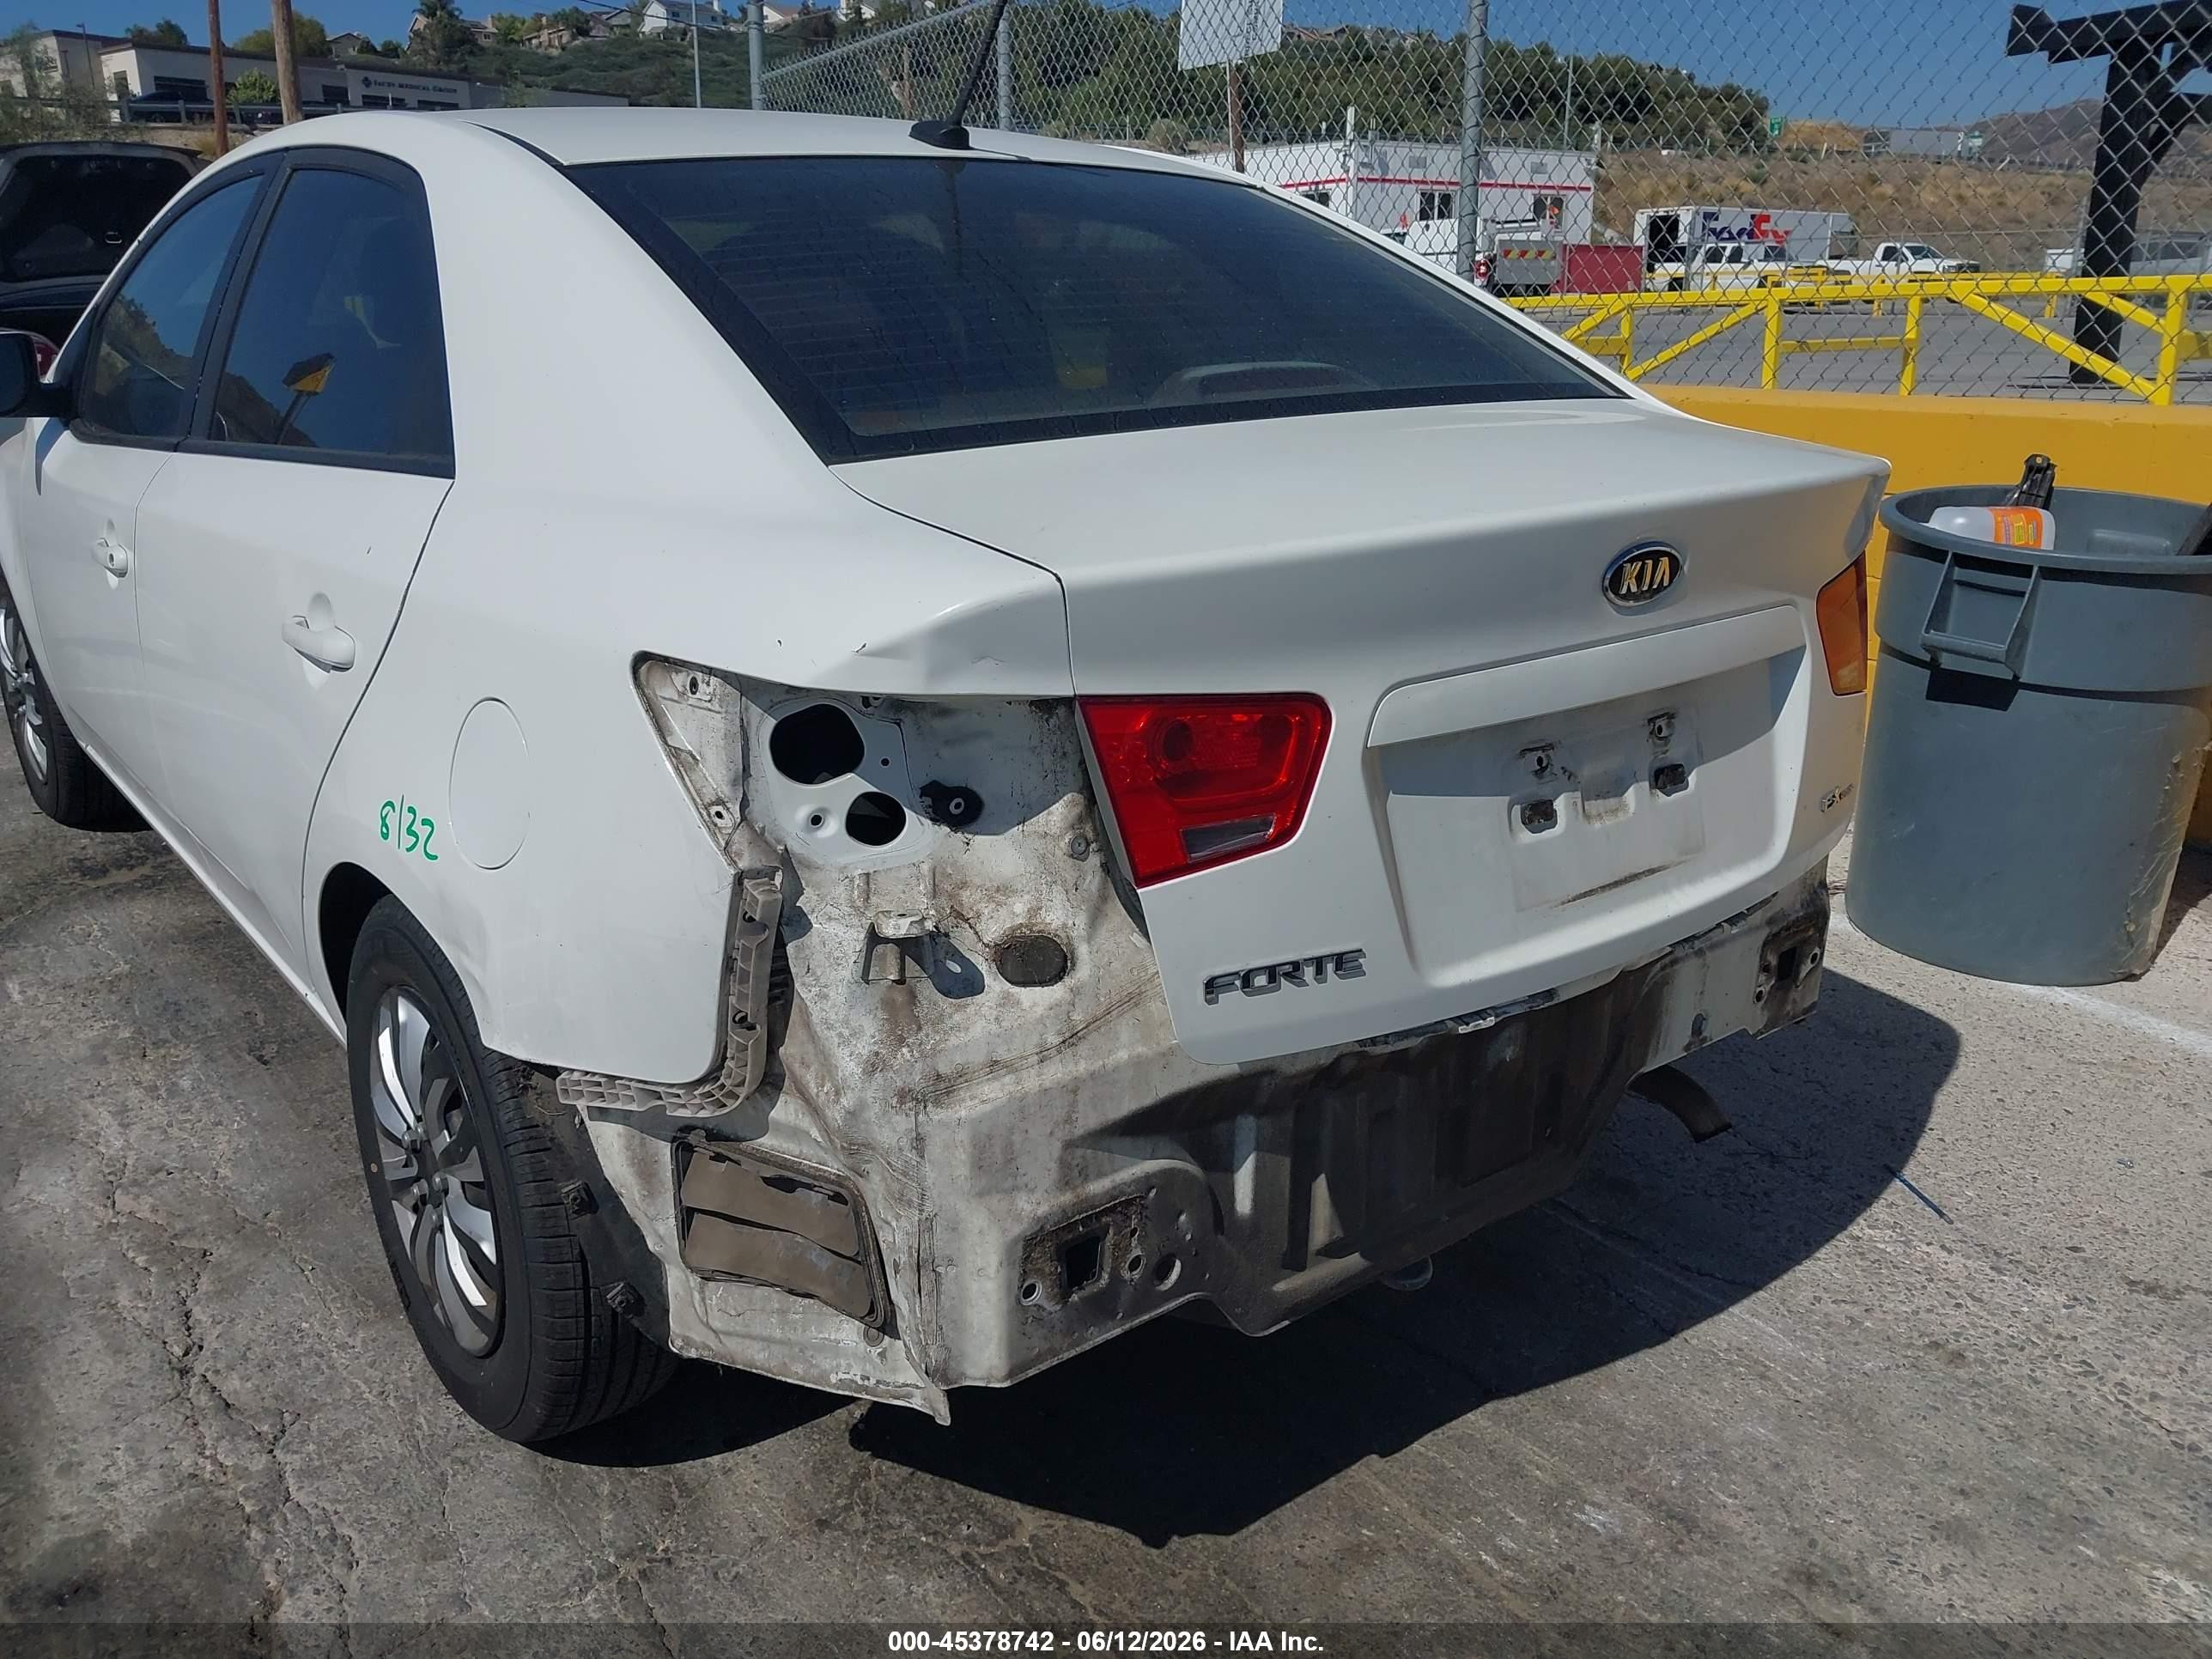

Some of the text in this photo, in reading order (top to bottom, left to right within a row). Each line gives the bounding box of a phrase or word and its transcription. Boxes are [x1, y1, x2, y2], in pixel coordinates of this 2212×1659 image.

[1702, 211, 1793, 243] FedEx
[1619, 556, 1670, 594] KIA
[1202, 947, 1367, 1006] FORTE
